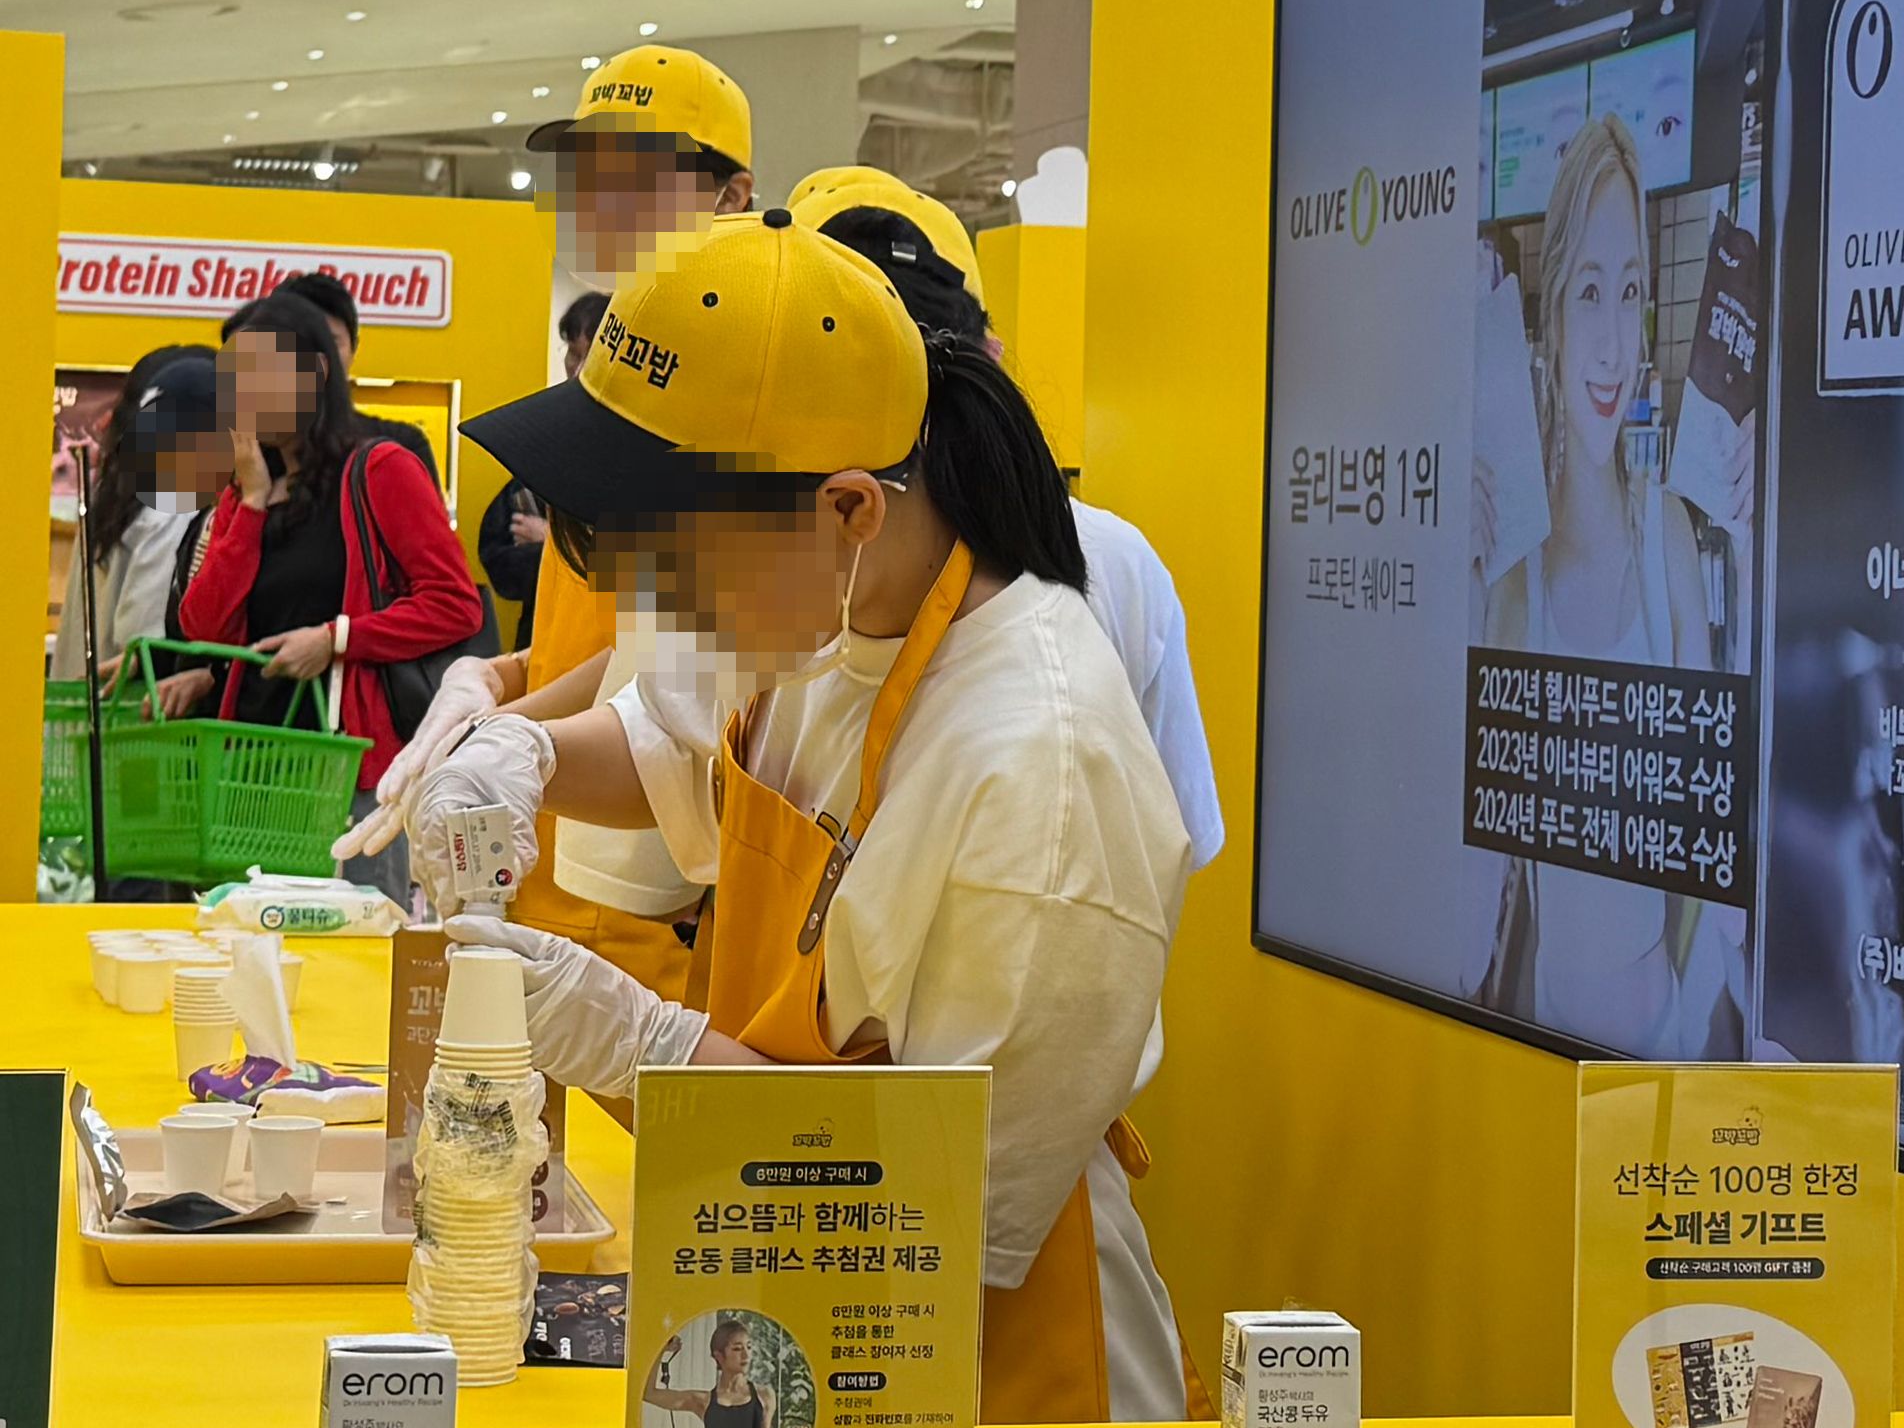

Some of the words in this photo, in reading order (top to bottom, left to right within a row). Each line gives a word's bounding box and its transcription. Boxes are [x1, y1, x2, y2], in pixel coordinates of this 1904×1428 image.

[1289, 189, 1346, 241] OLIVE
[1381, 166, 1456, 224] YOUNG
[57, 253, 181, 297] rotein
[1289, 445, 1385, 526] 올리브영
[1398, 443, 1440, 527] 1위
[1305, 555, 1356, 610] 프로틴
[1478, 665, 1540, 719] 2022년
[1545, 671, 1619, 728] 헬시푸드
[1624, 681, 1687, 738] 어워즈
[1690, 689, 1736, 748] 수상
[1476, 726, 1539, 782] 2023년
[1544, 735, 1618, 797] 이너뷰티
[1624, 748, 1686, 805] 어워즈
[1689, 757, 1735, 818] 수상
[1473, 787, 1536, 844] 2024년
[1539, 797, 1578, 849] 푸드
[1581, 806, 1619, 864] 전체
[1625, 815, 1687, 873] 어워즈
[1691, 827, 1736, 889] 수상
[756, 1167, 791, 1182] 6만원
[796, 1166, 820, 1181] 이상
[855, 1166, 867, 1181] 시
[1614, 1163, 1699, 1196] 선착순
[1709, 1163, 1792, 1196] 100명
[1803, 1163, 1858, 1196] 한정
[693, 1202, 805, 1233] 심으뜸과
[814, 1201, 925, 1232] 함께하는
[1644, 1211, 1731, 1245] 스페셜
[1740, 1211, 1826, 1245] 기프트
[673, 1247, 722, 1274] 운동
[730, 1246, 804, 1273] 클래스
[811, 1245, 885, 1273] 추첨권
[893, 1245, 941, 1272] 제공
[1764, 1262, 1789, 1274] GIFT
[832, 1305, 865, 1318] 6만원
[868, 1304, 892, 1318] 이상
[923, 1304, 935, 1318] 시
[1258, 1345, 1349, 1368] erom
[343, 1372, 443, 1397] erom
[1257, 1406, 1298, 1422] 국산콩
[1302, 1405, 1329, 1422] 두유
